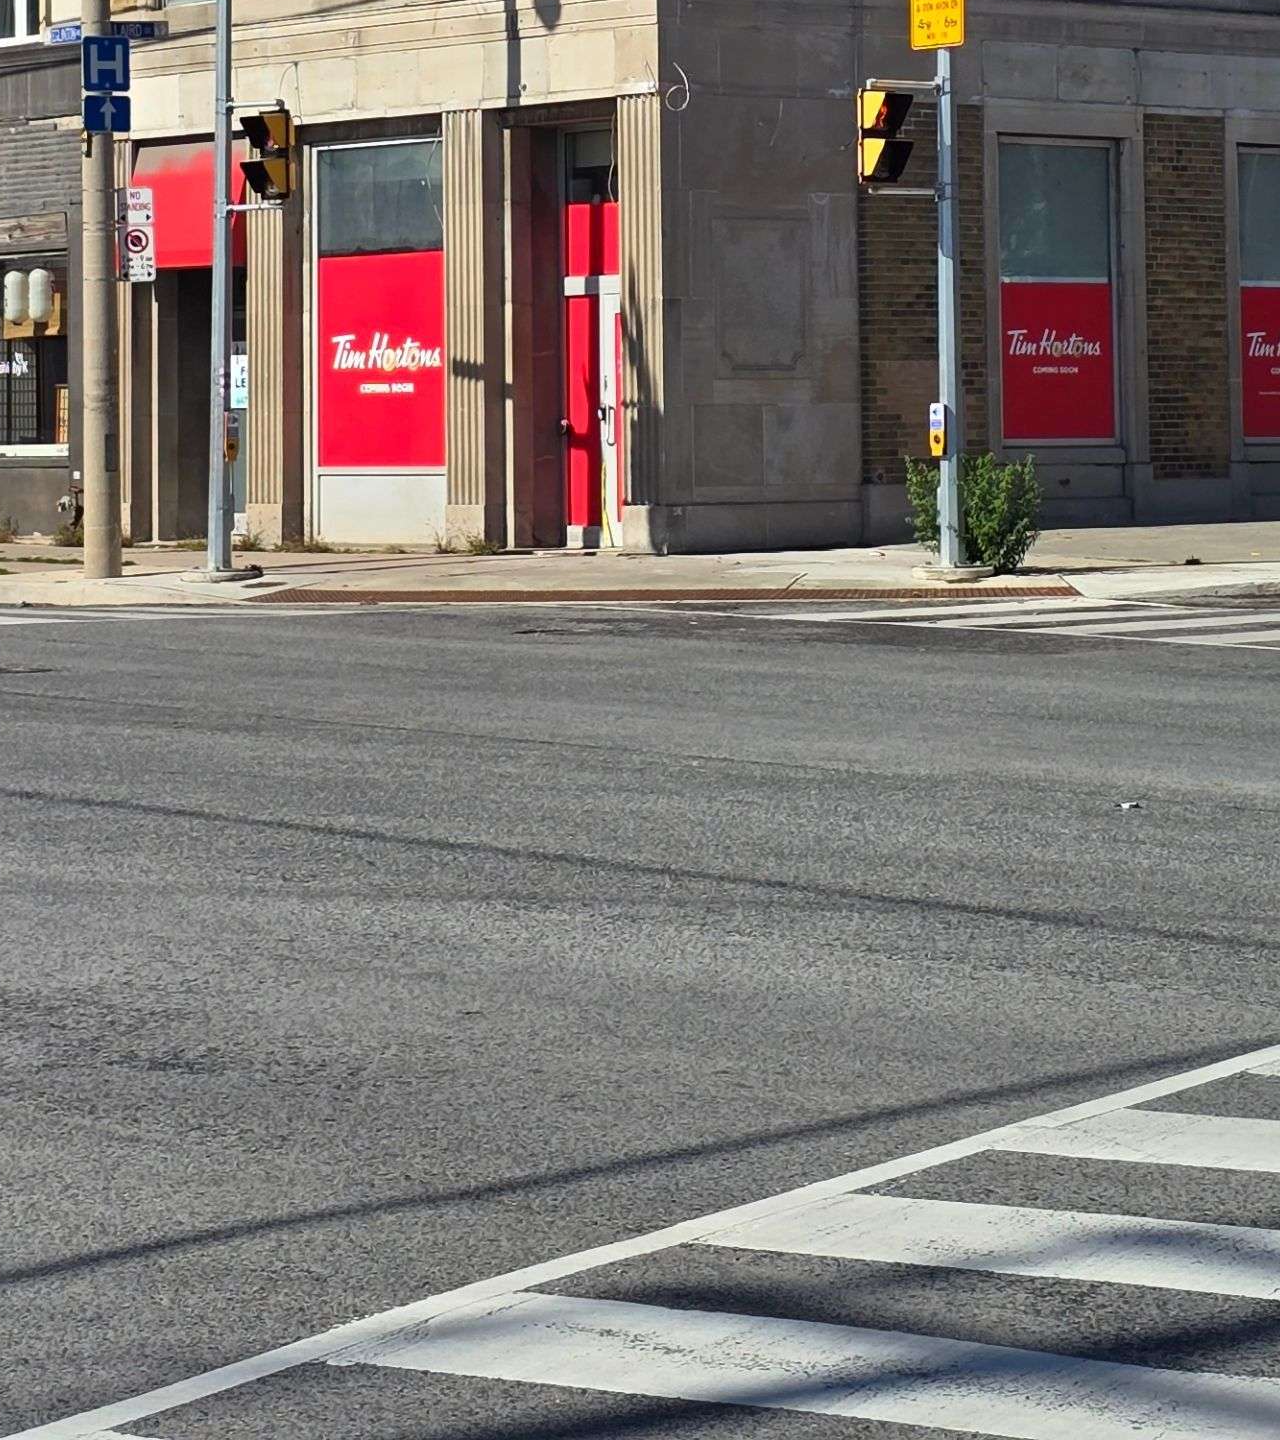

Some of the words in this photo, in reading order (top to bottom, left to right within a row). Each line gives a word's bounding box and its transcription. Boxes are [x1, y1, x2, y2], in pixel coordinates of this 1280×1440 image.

[90, 44, 124, 84] H
[119, 203, 152, 212] STANDING
[129, 191, 141, 200] NO
[331, 334, 366, 370] Tim
[368, 331, 442, 372] Hortons
[1007, 329, 1037, 356] Tim
[1039, 328, 1101, 357] Hortons
[1246, 331, 1275, 357] Tim
[1032, 366, 1059, 375] COMING
[1060, 366, 1079, 375] SOON
